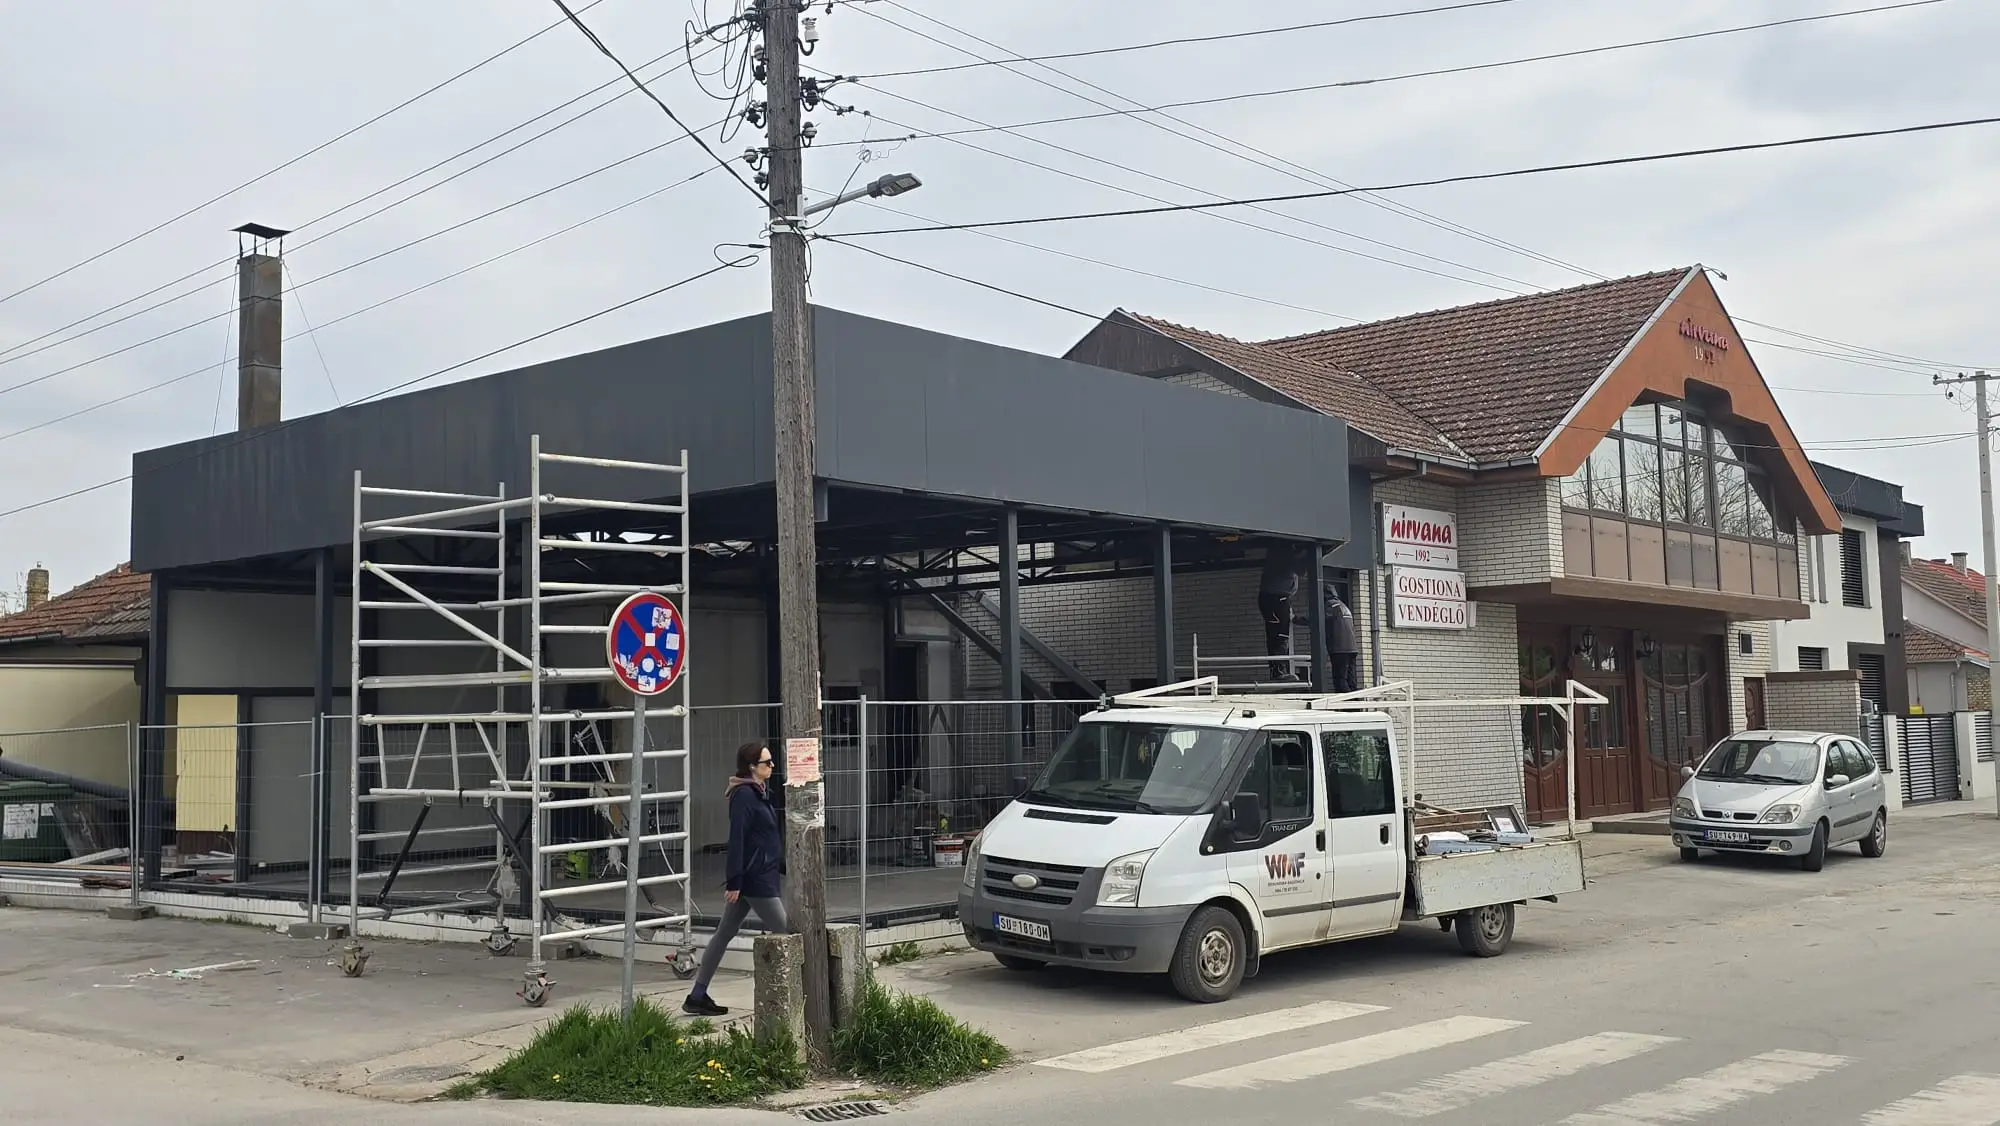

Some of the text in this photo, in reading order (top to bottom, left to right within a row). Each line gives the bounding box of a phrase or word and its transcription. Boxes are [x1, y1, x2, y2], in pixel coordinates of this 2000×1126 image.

[1679, 317, 1729, 351] nirvana
[1391, 511, 1452, 544] nirvana
[1415, 549, 1430, 562] 1992
[1399, 576, 1461, 597] GOSTIONA
[1272, 824, 1298, 833] TRANSIT
[1709, 831, 1718, 840] SU
[1264, 852, 1306, 880] WMF
[1000, 917, 1011, 930] SU
